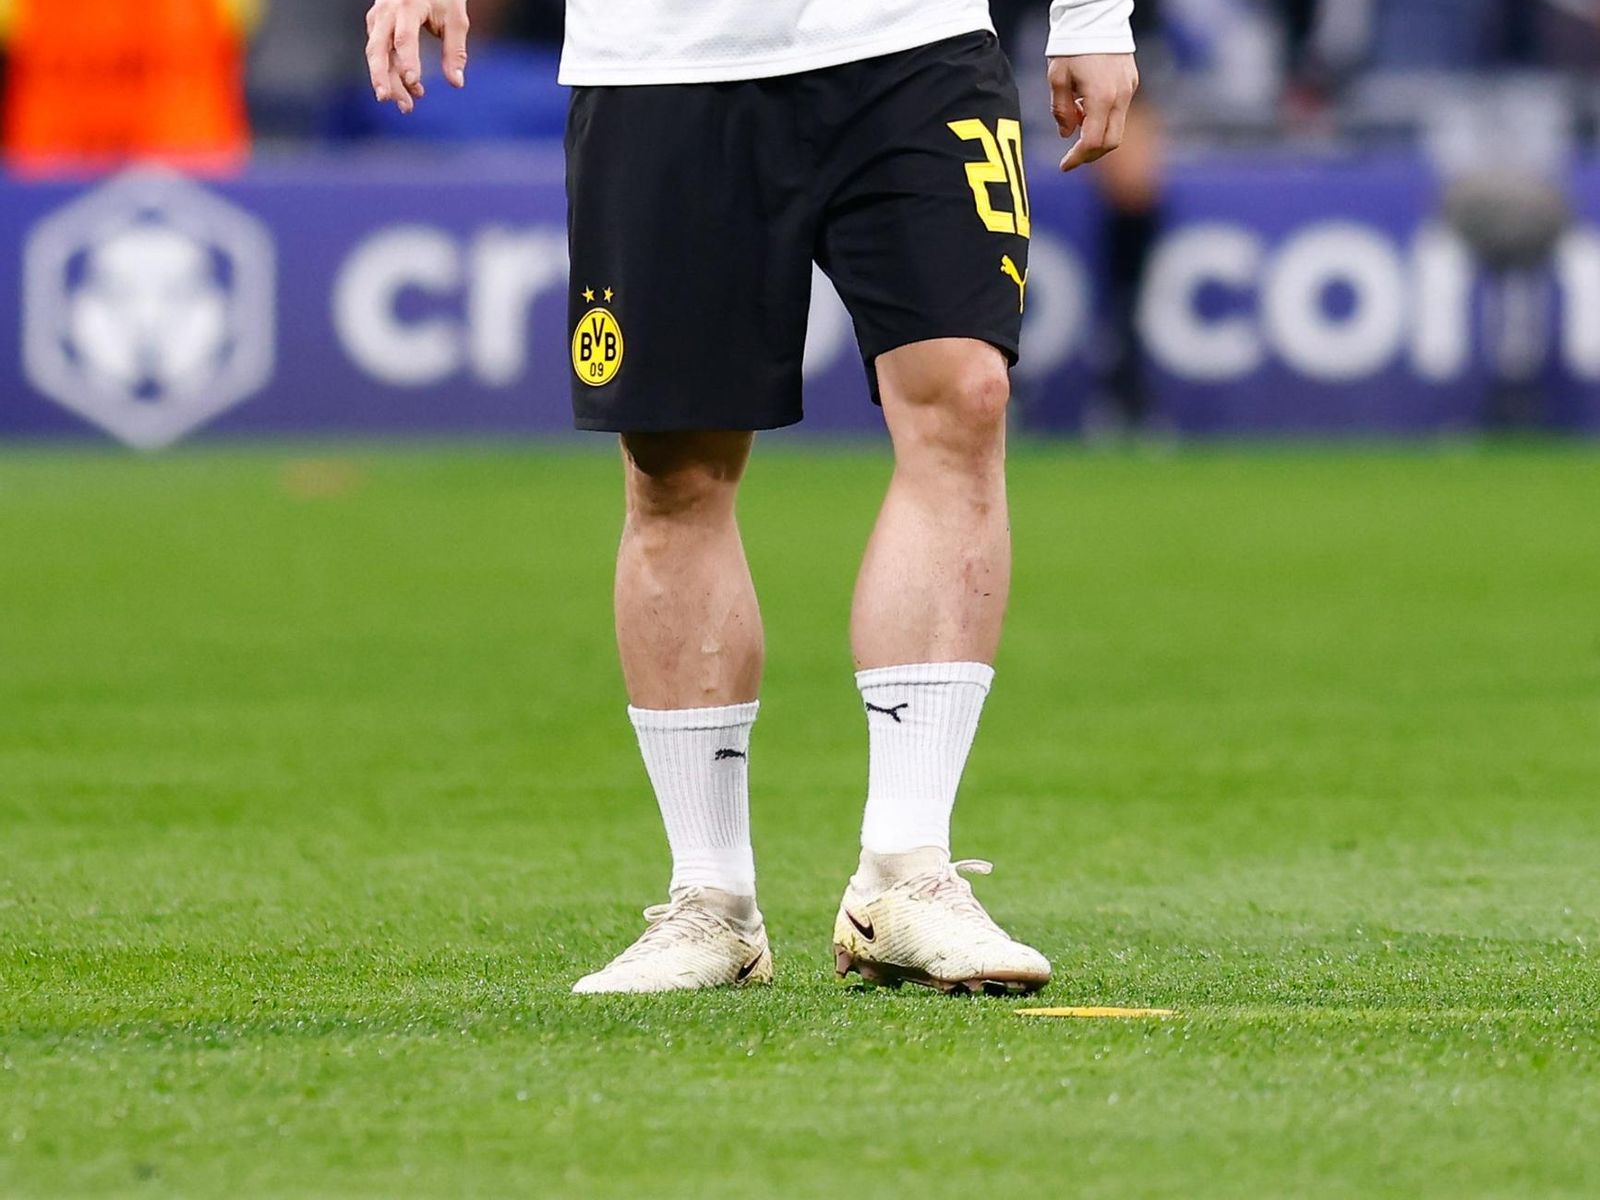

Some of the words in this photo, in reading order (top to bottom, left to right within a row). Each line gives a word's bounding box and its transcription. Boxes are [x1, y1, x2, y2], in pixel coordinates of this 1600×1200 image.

[945, 118, 1031, 240] 20
[580, 317, 617, 362] BVB
[589, 362, 605, 378] 09
